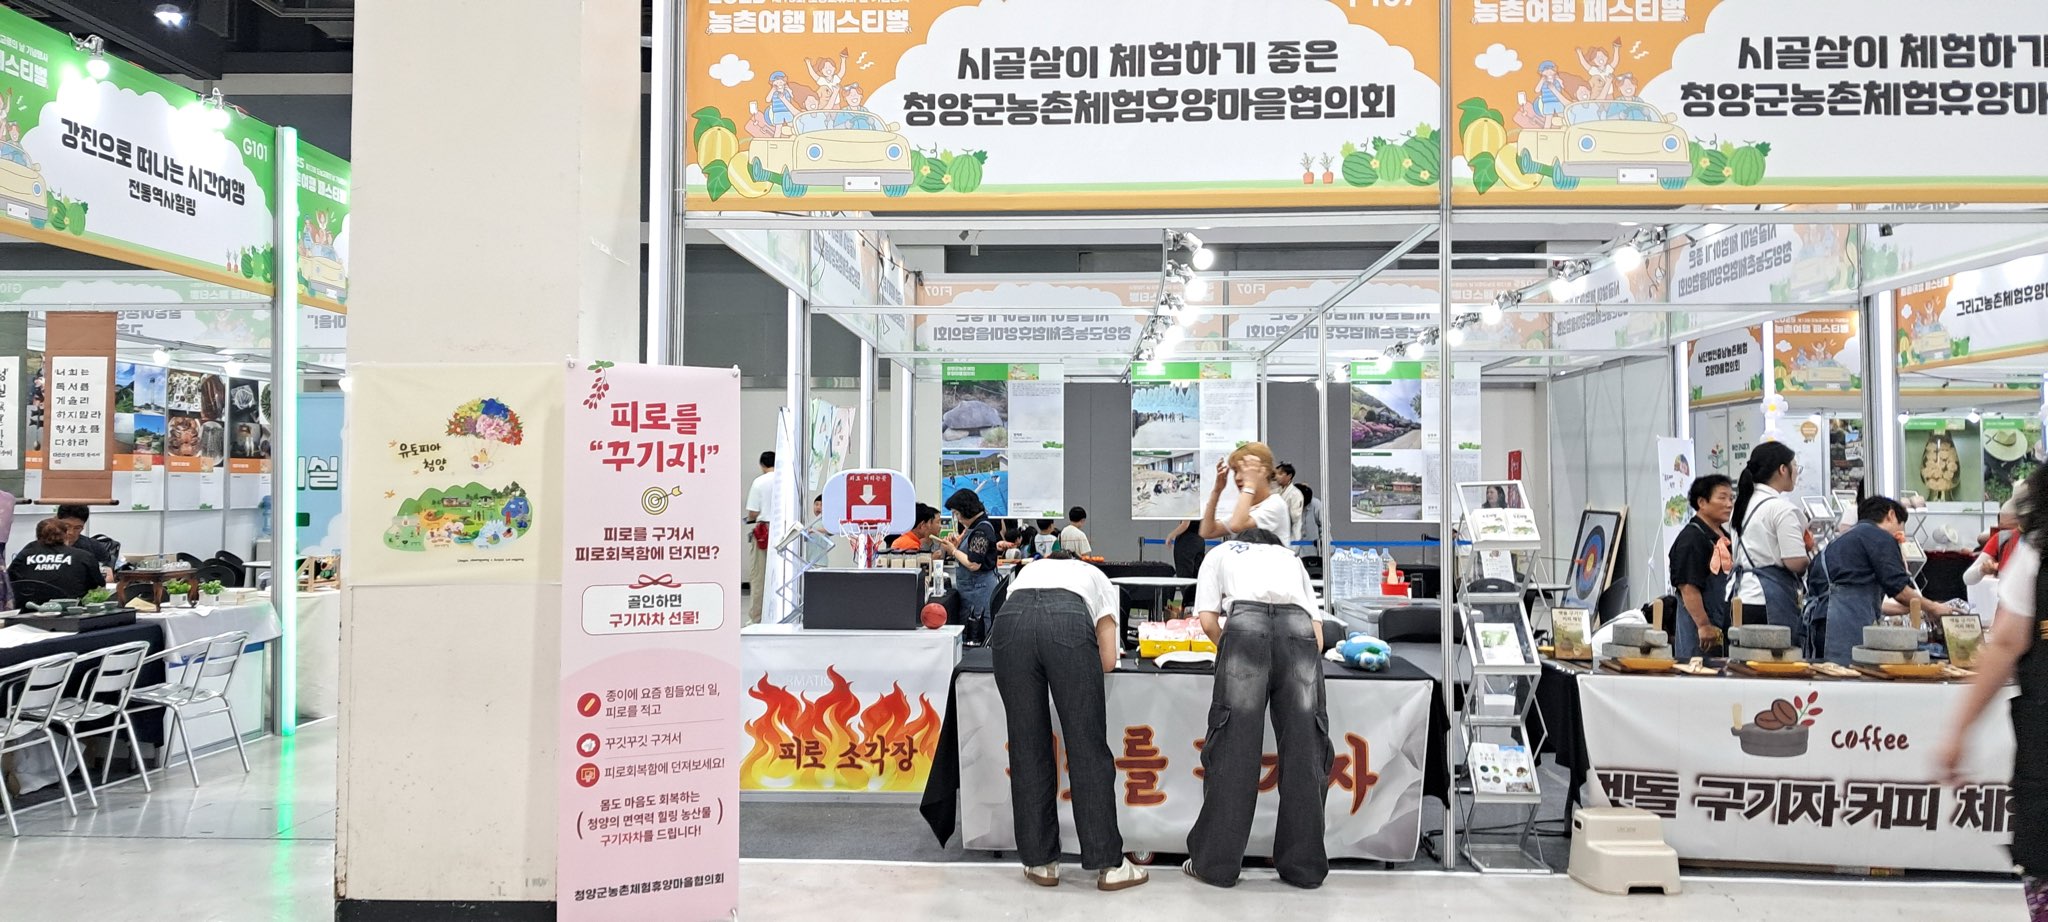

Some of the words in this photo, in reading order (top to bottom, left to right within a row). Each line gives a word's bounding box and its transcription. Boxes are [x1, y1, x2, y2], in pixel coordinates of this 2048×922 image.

[708, 9, 805, 34] 농촌여행
[812, 9, 909, 33] 페스티벌
[1474, 0, 1576, 23] 농촌여행
[1583, 0, 1686, 22] 페스티벌
[957, 46, 1099, 80] 시골살이
[1109, 40, 1256, 78] 체험하기
[1267, 39, 1338, 74] 좋은
[1738, 35, 1888, 70] 시골살이
[1900, 33, 2048, 69] 체험하기
[903, 83, 1396, 127] 청양군농촌체험휴양마을협의회
[242, 137, 268, 163] G101
[60, 118, 132, 167] 강진으로
[136, 146, 184, 185] 떠나는
[188, 164, 245, 206] 시간여행
[128, 178, 196, 217] 전통역사힐링
[611, 401, 701, 435] 피로를
[398, 443, 441, 459] 유토피아
[423, 458, 447, 472] 청양
[603, 527, 647, 542] 피로를
[652, 527, 694, 541] 구겨서
[26, 554, 72, 566] KOREA
[575, 545, 664, 562] 피로회복함에
[669, 545, 720, 560] 던지면?
[34, 563, 62, 571] ARMY
[628, 594, 682, 609] 골인하면
[609, 612, 664, 628] 구기자차
[668, 611, 700, 625] 선물!
[606, 688, 638, 703] 종이에
[640, 686, 661, 700] 요즘
[664, 684, 705, 699] 힘들었던
[707, 683, 720, 697] 일,
[606, 705, 638, 719] 피로를
[640, 705, 662, 716] 적고
[605, 735, 648, 751] 꾸깃꾸깃
[650, 732, 682, 747] 구겨서
[1831, 723, 1910, 752] coffee
[778, 735, 826, 770] 피로
[837, 735, 919, 776] 소각장
[604, 761, 668, 779] 피로회복함에
[671, 757, 725, 774] 던져보세요!
[600, 797, 621, 811] 몸도
[624, 795, 656, 809] 마음도
[658, 791, 700, 806] 회복하는
[1952, 784, 2016, 833] 체
[587, 816, 620, 831] 청양의
[622, 813, 655, 828] 면역력
[657, 810, 678, 824] 힐링
[680, 806, 711, 820] 농산물
[600, 829, 654, 847] 구기자차를
[656, 825, 702, 841] 드립니다!
[574, 872, 725, 902] 청양군농촌체험휴양마을협의회
